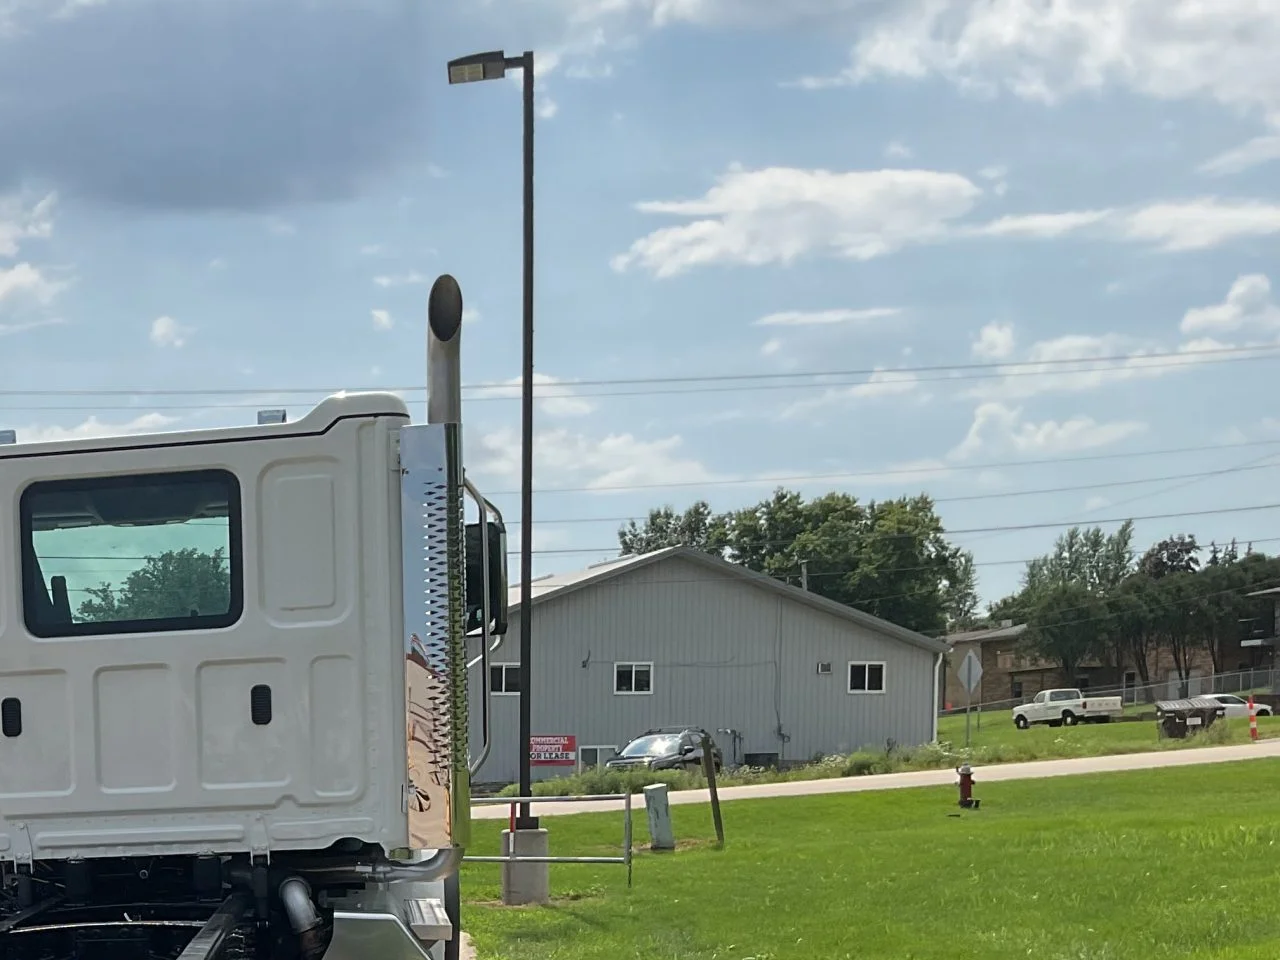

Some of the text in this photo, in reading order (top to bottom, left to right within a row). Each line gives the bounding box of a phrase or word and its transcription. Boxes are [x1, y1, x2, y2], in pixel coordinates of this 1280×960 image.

[530, 736, 569, 744] OMMERCIAL
[530, 752, 570, 760] OR LEASE
